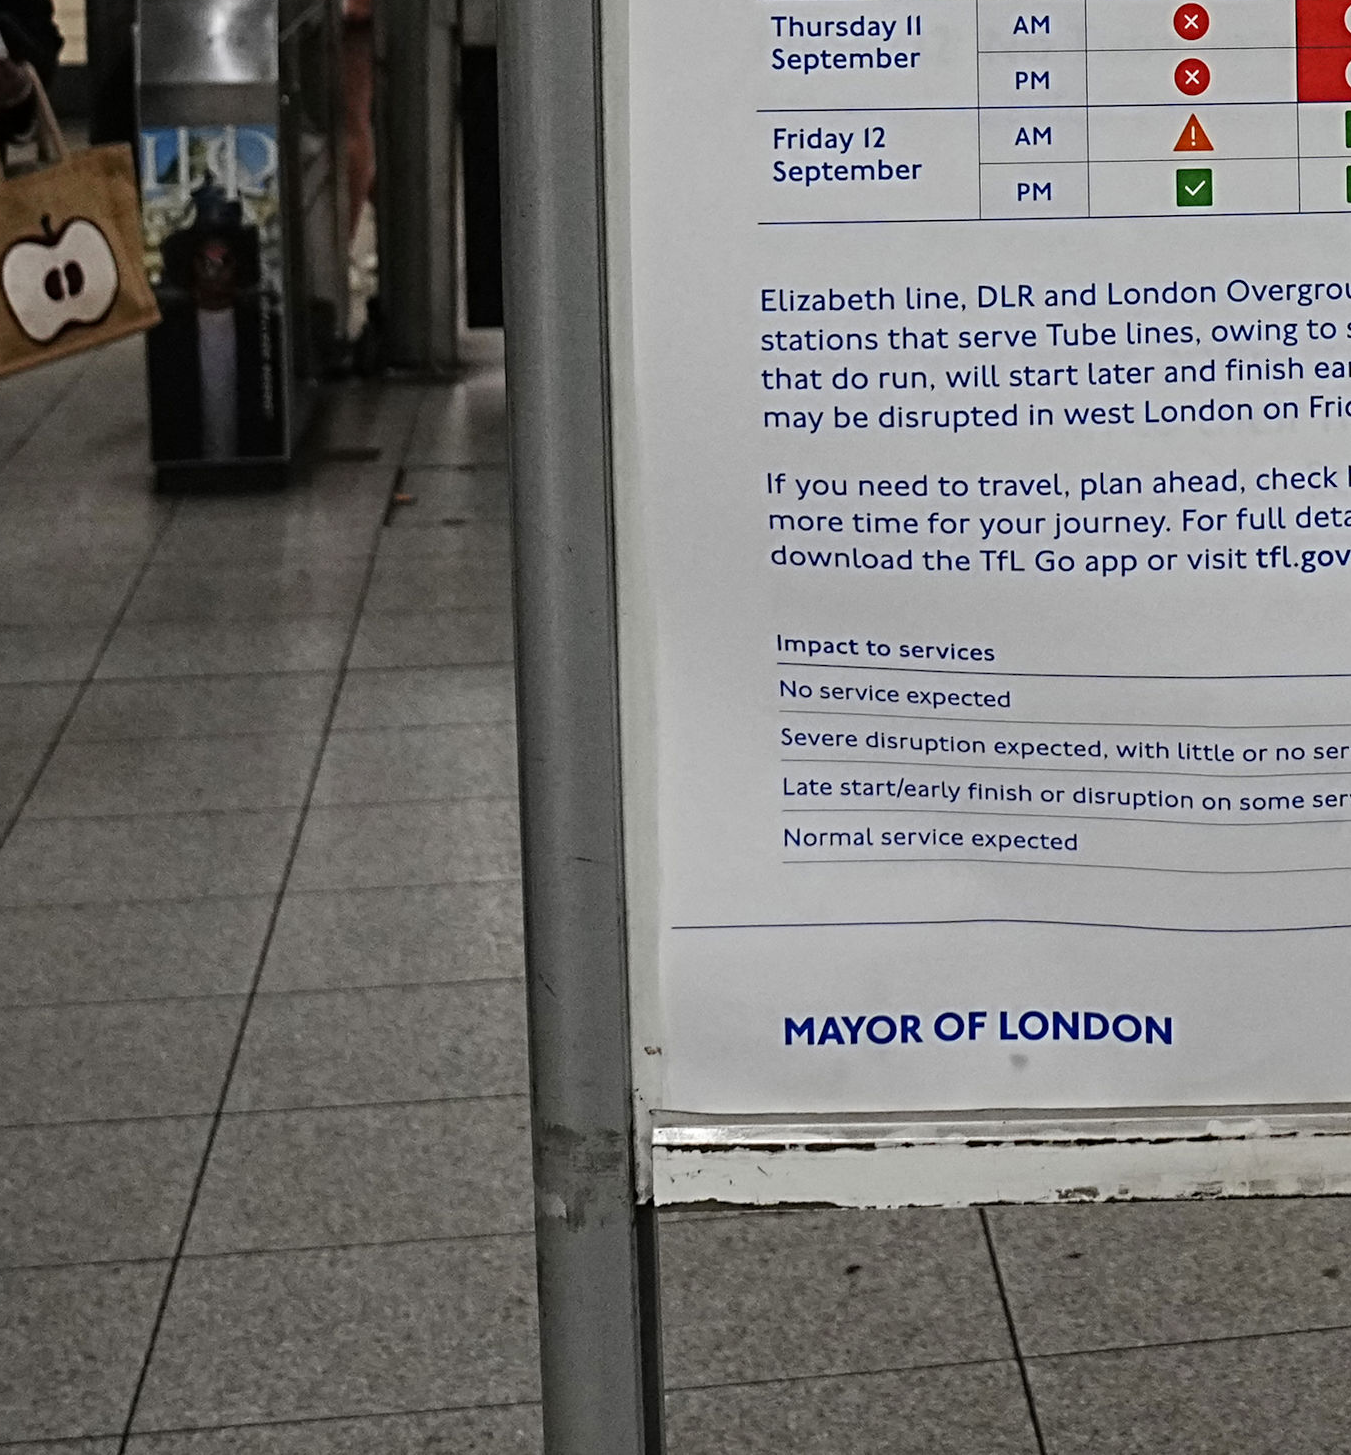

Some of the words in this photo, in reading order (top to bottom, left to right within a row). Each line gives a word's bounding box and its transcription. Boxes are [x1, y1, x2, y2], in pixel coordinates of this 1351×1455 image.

[770, 14, 898, 42] Thursday
[906, 14, 922, 36] 11
[771, 46, 921, 76] September
[773, 126, 855, 155] Friday
[864, 126, 886, 149] 12
[772, 158, 923, 188] September
[761, 286, 895, 313] Elizabeth
[905, 286, 967, 312] line,
[977, 284, 1036, 309] DLR
[1044, 282, 1097, 308] and
[1107, 280, 1217, 306] London
[763, 411, 824, 435] may
[833, 405, 869, 429] be
[878, 402, 1018, 434] disrupted
[1029, 403, 1054, 426] in
[1063, 402, 1135, 426] west
[1144, 398, 1253, 424] London
[1263, 401, 1299, 421] on
[767, 472, 787, 495] If
[794, 478, 848, 501] you
[858, 474, 928, 497] need
[937, 476, 969, 498] to
[977, 472, 1070, 499] travel,
[1080, 471, 1142, 502] plan
[1152, 468, 1246, 495] ahead,
[1255, 465, 1339, 491] check
[770, 544, 913, 571] download
[921, 549, 971, 572] the
[978, 549, 1026, 572] TfL
[1034, 549, 1075, 573] Go
[1085, 554, 1138, 578] app
[1147, 553, 1178, 572] or
[1186, 547, 1248, 571] visit
[776, 633, 860, 658] Impact
[865, 639, 891, 657] to
[899, 642, 996, 662] services
[779, 679, 813, 699] No
[819, 684, 900, 703] service
[906, 690, 1011, 710] expected
[783, 776, 833, 797] Late
[840, 777, 961, 804] start/early
[967, 782, 1032, 802] finish
[1040, 789, 1066, 804] or
[1072, 786, 1194, 811] disruption
[1201, 796, 1232, 811] on
[1239, 795, 1305, 812] some
[783, 826, 874, 848] Normal
[880, 828, 964, 847] service
[971, 833, 1078, 853] expected
[784, 1014, 924, 1046] MAYOR
[933, 1010, 988, 1042] OF
[999, 1010, 1173, 1046] LONDON
